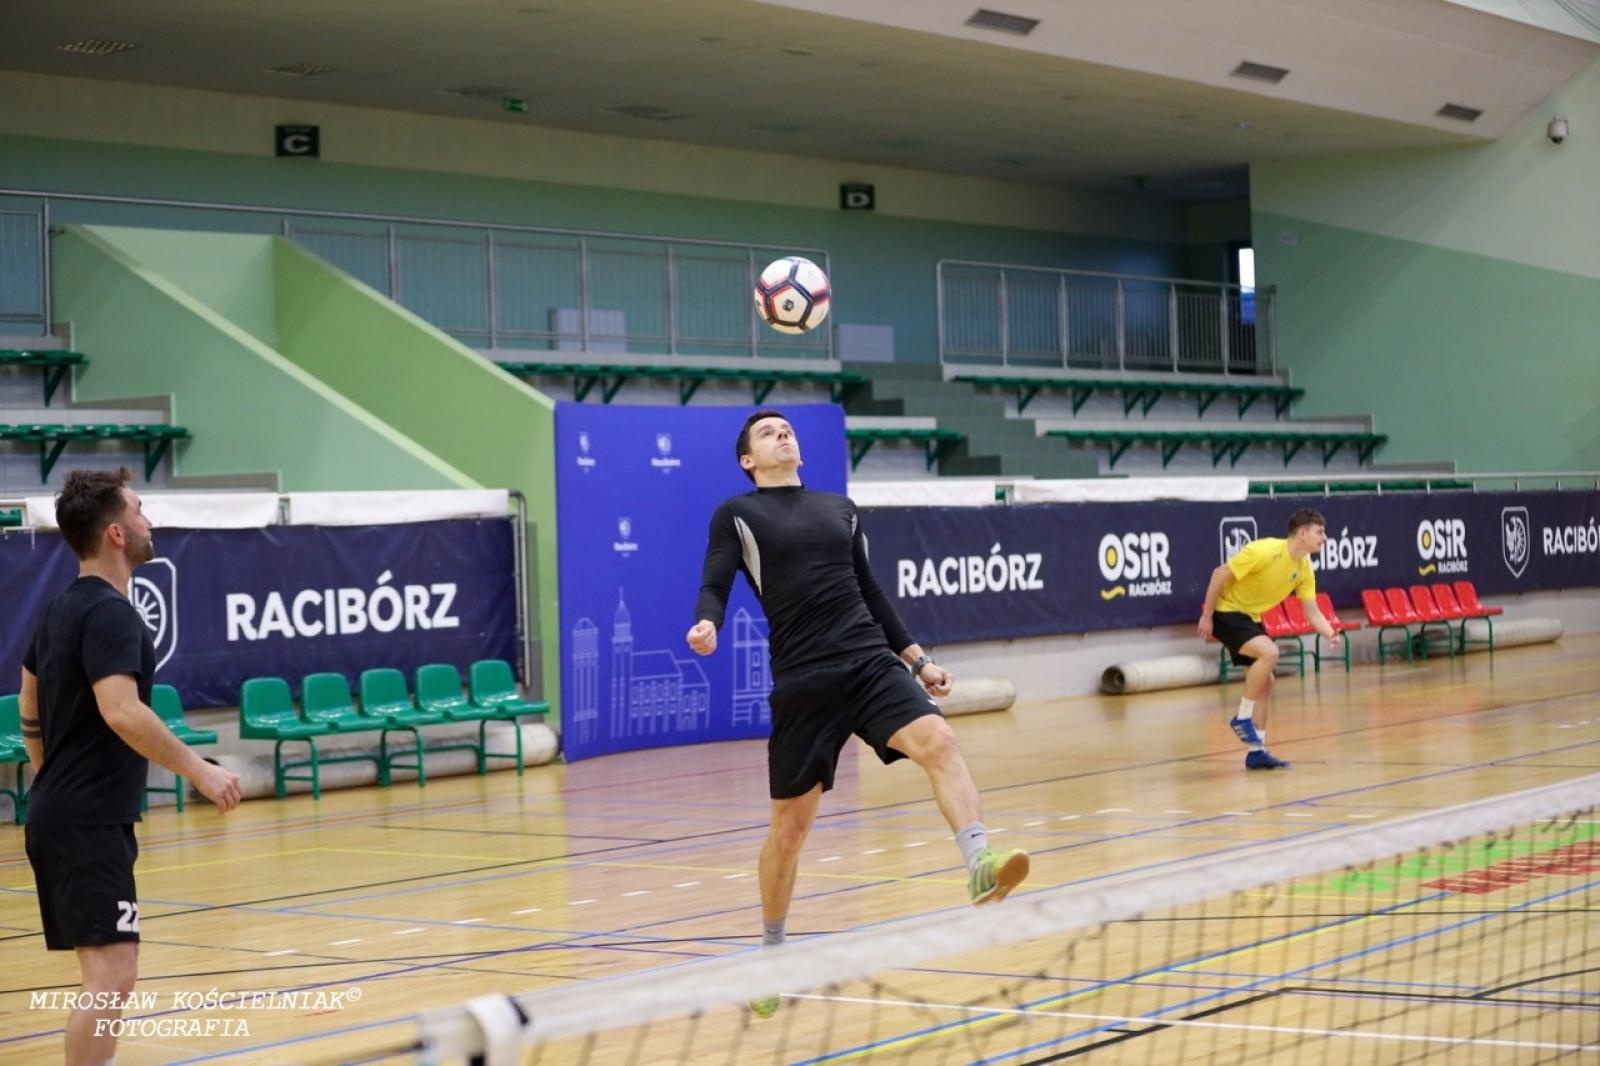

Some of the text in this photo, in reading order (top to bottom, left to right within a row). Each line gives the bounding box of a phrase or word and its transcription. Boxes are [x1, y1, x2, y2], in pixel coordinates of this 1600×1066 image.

[284, 135, 310, 152] C
[847, 192, 870, 207] D
[1543, 516, 1600, 555] RACIBÓ
[898, 542, 1044, 598] RACIBÓRZ
[226, 569, 460, 641] RACIBÓRZ
